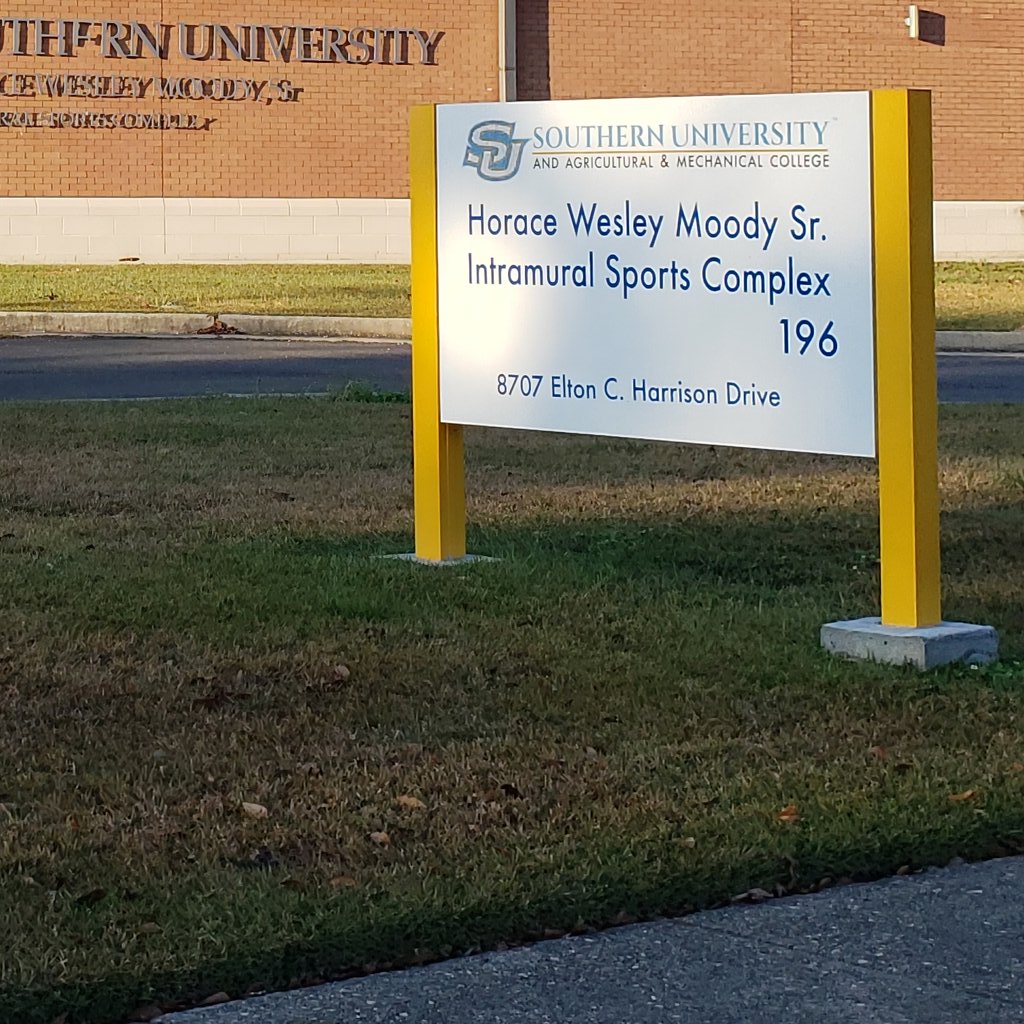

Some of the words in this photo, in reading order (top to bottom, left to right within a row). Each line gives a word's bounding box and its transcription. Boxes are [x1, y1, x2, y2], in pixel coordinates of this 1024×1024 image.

[178, 22, 444, 65] UNIVERSITY
[34, 73, 152, 98] WESLEY
[463, 120, 532, 182] SU
[532, 124, 664, 149] SOUTHERN
[671, 120, 830, 147] UNIVERSITY
[532, 157, 559, 169] AND
[565, 155, 654, 169] AGRICULTURAL
[660, 154, 670, 168] &
[676, 154, 763, 168] MECHANICAL
[769, 154, 830, 168] COLLEGE
[468, 203, 558, 236] Horace
[566, 199, 664, 248] Wesley
[676, 200, 779, 251] Moody
[789, 204, 827, 242] Sr.
[468, 251, 594, 287] Intramural
[605, 253, 691, 299] Sports
[701, 255, 832, 306] Complex
[779, 318, 839, 357] 196
[497, 373, 544, 398] 8707
[551, 374, 597, 400] Elton
[603, 377, 624, 401] C.
[632, 378, 718, 405] Harrison
[726, 381, 781, 407] Drive
